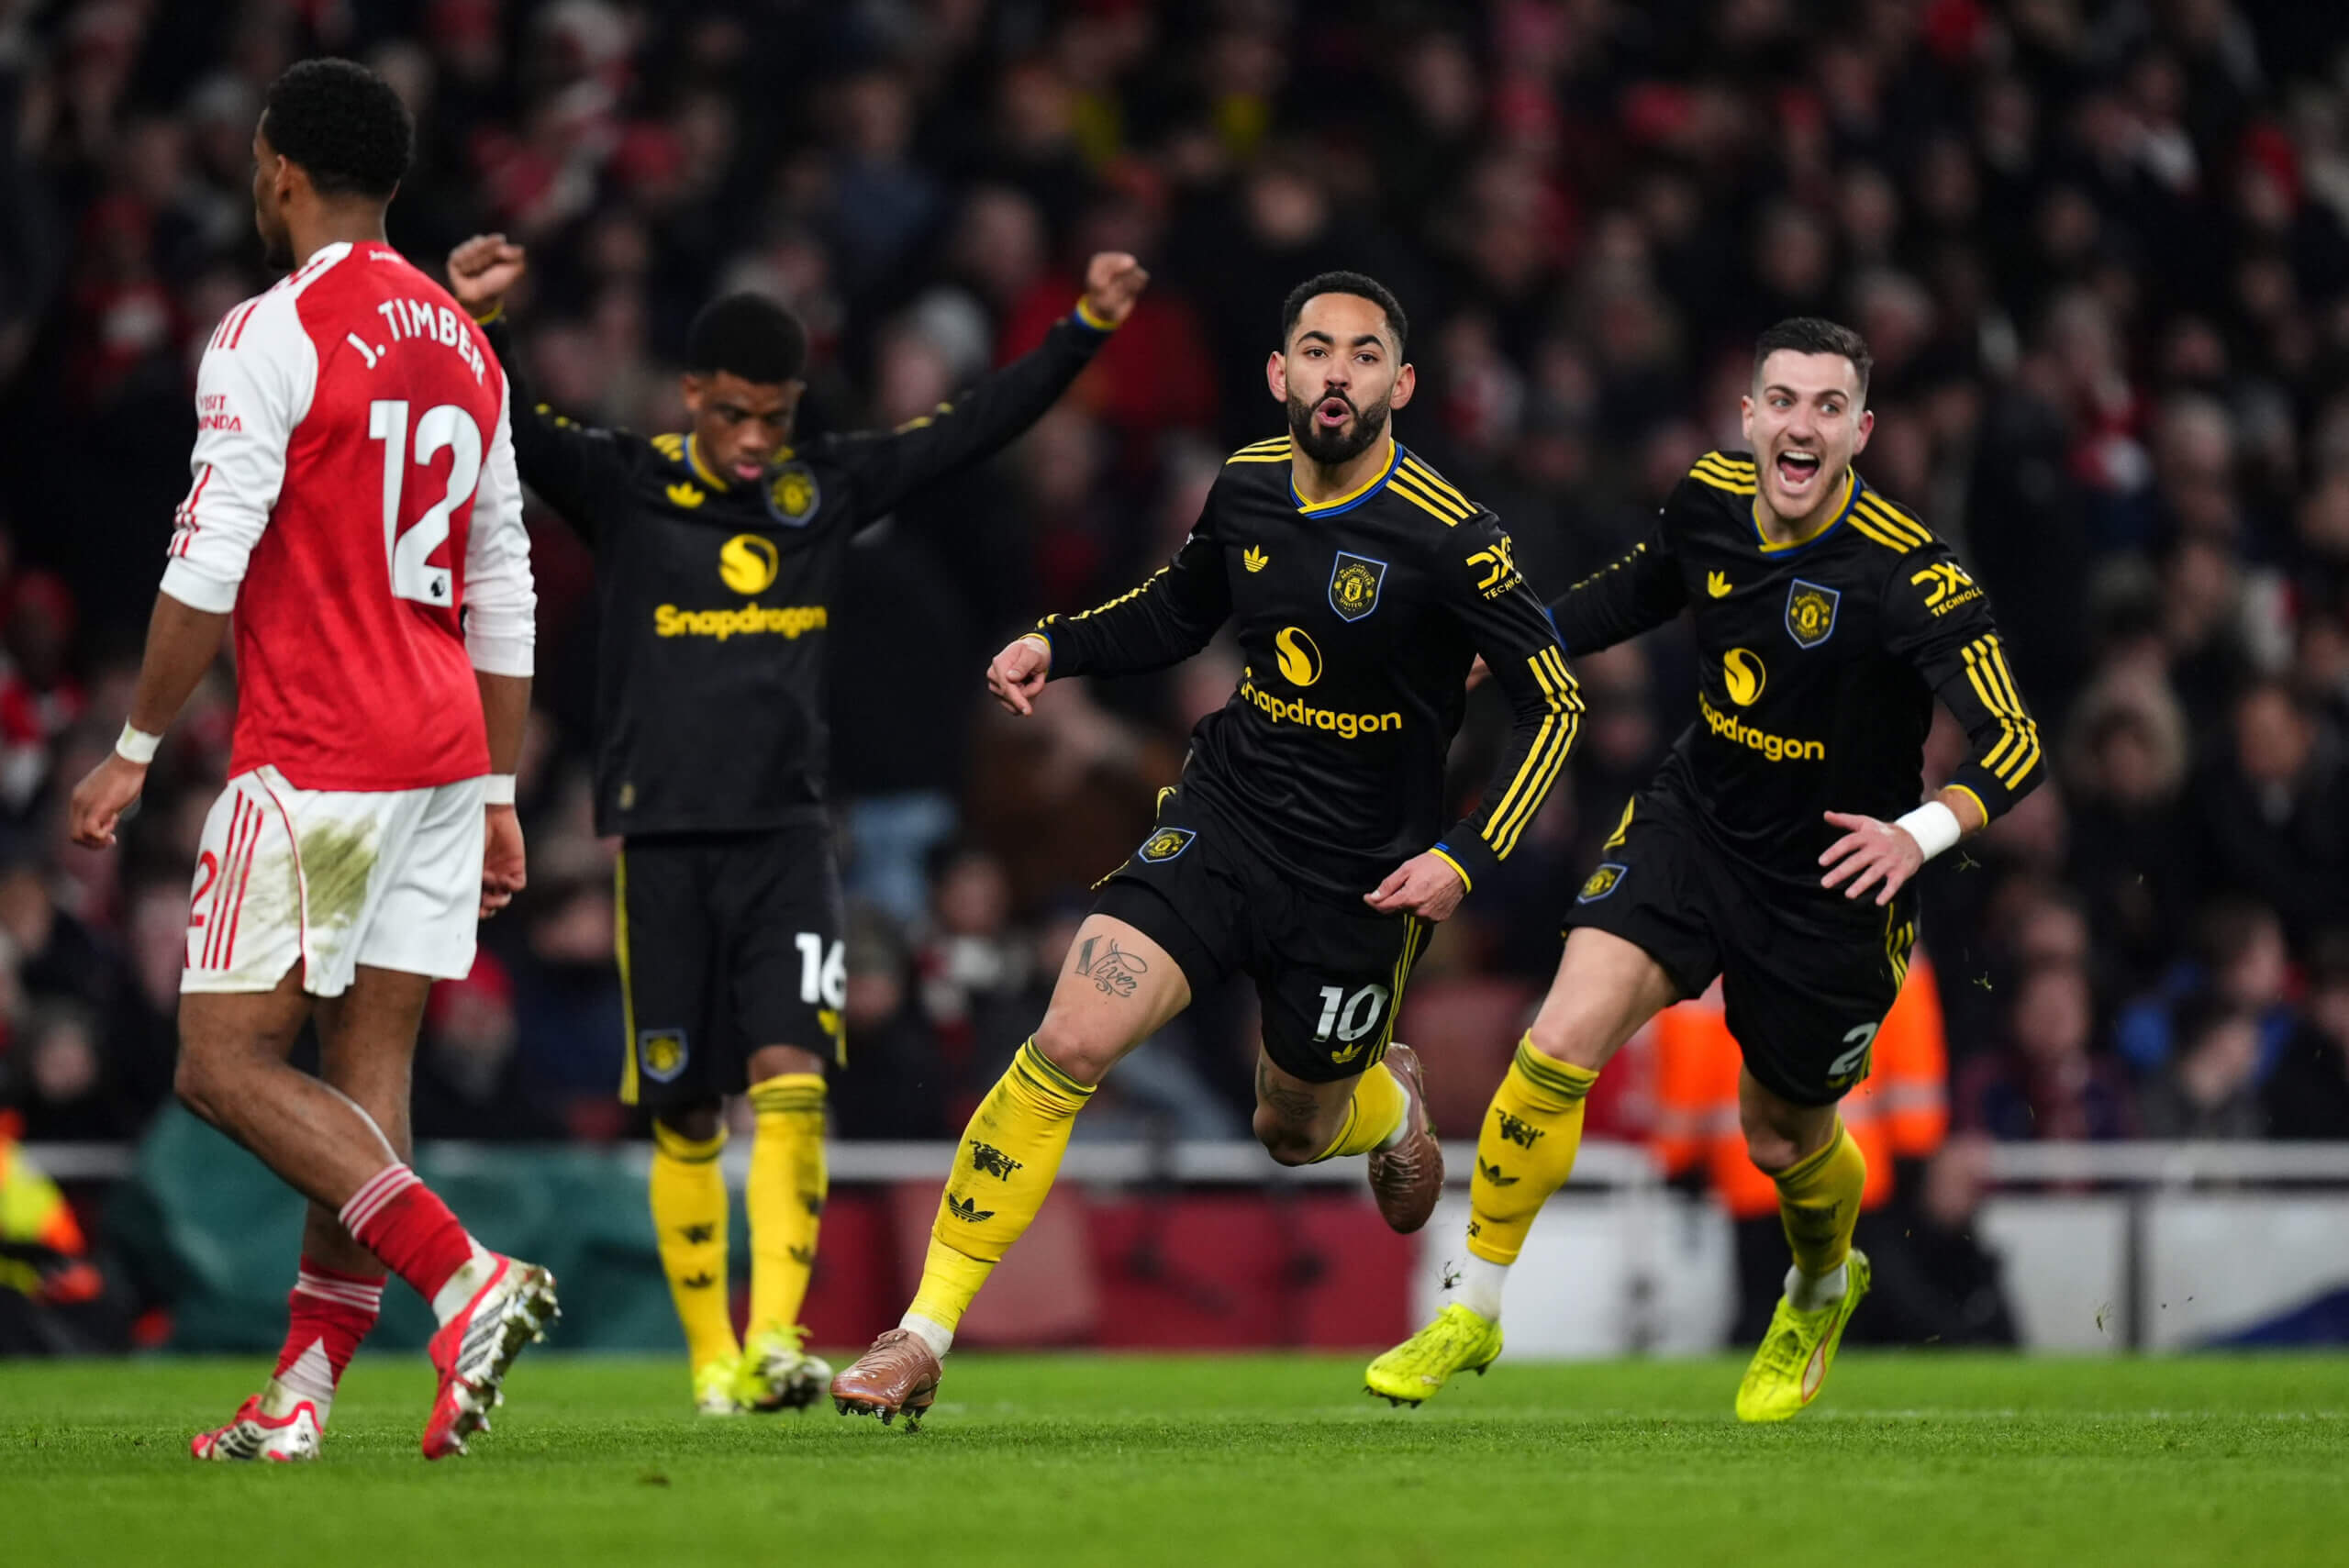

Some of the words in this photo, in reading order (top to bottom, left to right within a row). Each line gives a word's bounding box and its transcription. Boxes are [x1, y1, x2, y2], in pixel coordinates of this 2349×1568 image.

[346, 331, 386, 370] J.
[377, 297, 485, 386] TIMBER
[369, 399, 483, 608] 12
[1482, 572, 1522, 600] TECHNO
[654, 601, 828, 642] Snapdragon
[795, 931, 847, 1010] 16
[1312, 983, 1389, 1042] 10
[1827, 1021, 1878, 1075] 2
